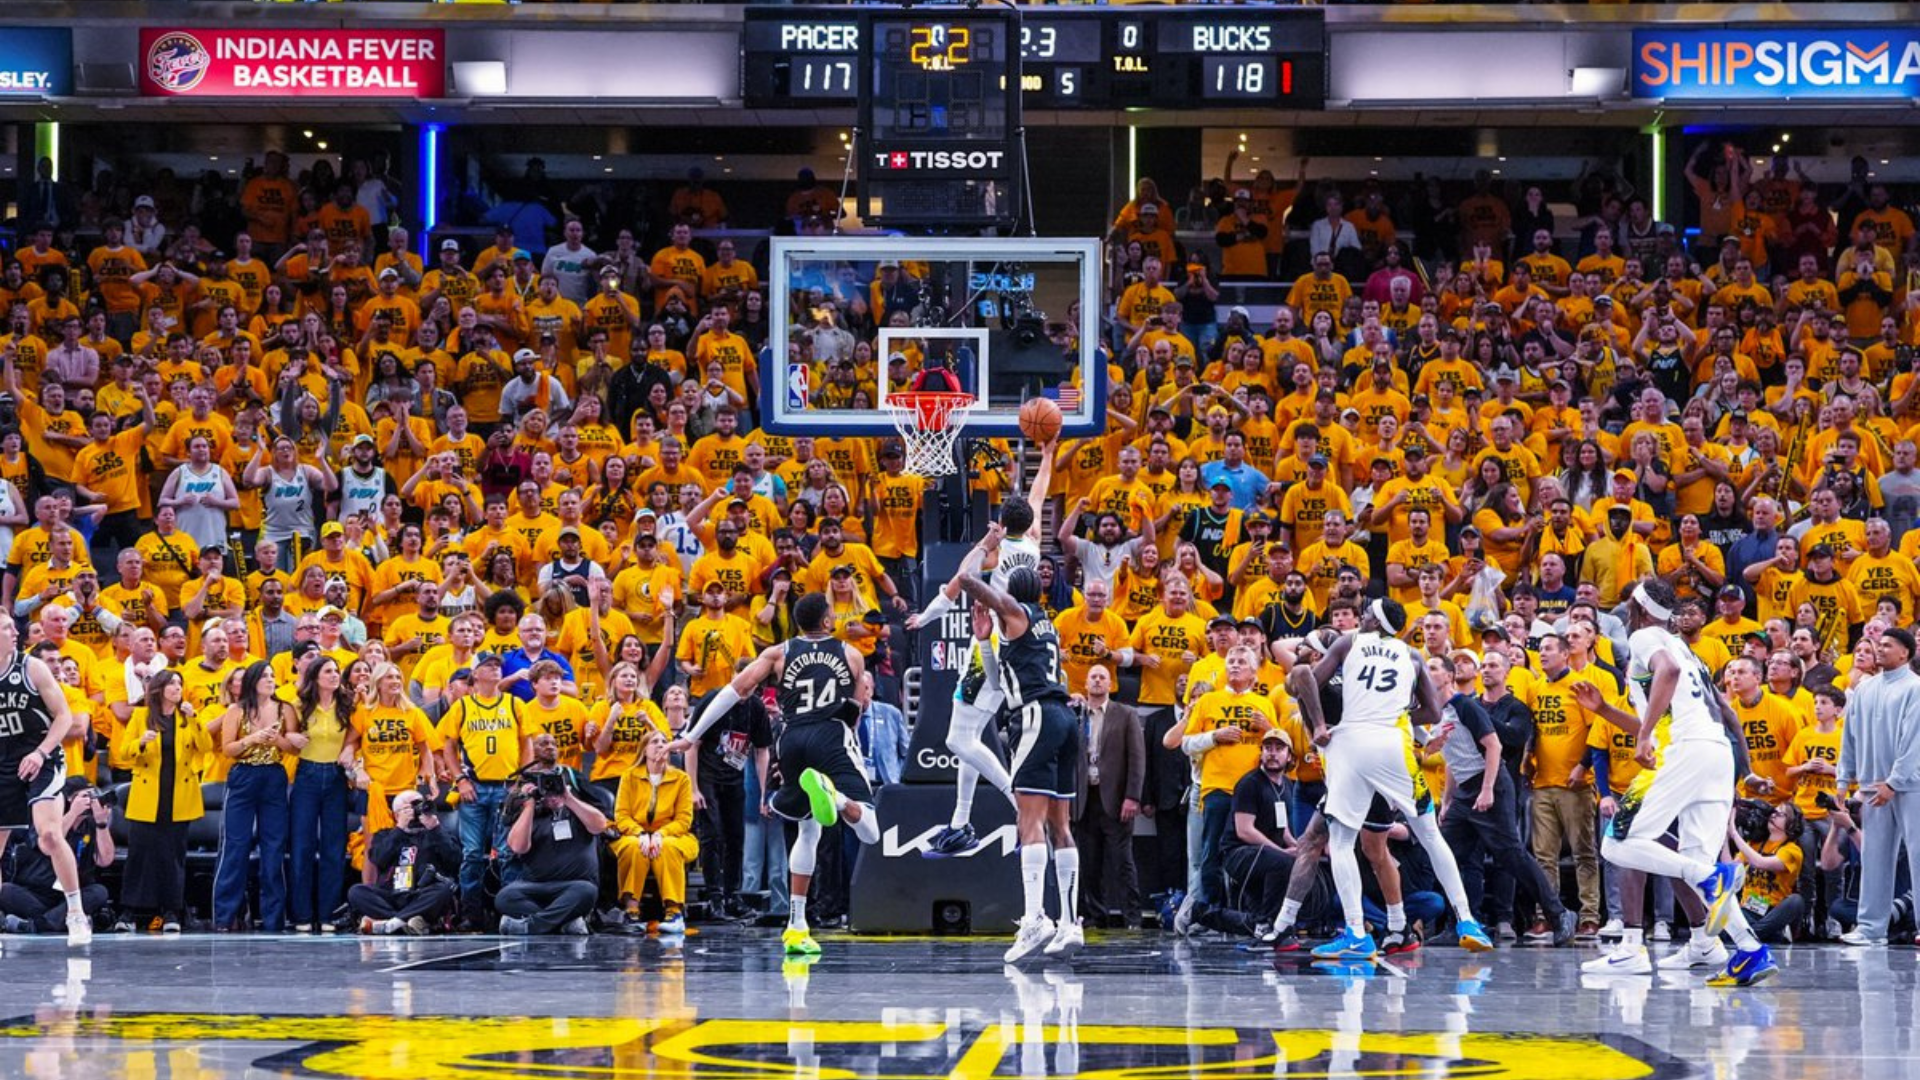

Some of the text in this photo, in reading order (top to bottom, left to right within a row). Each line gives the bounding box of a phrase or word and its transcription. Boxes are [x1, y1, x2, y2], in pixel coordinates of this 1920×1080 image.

[782, 25, 859, 50] PACER
[1123, 25, 1137, 48] 0
[1192, 26, 1271, 51] BUCKS
[216, 38, 435, 60] INDIANA FEVER
[1114, 57, 1148, 71] T.O.L.
[234, 65, 418, 87] BASKETBALL
[803, 63, 851, 90] 117
[1216, 63, 1264, 92] 118
[910, 151, 1004, 168] TISSOT
[1312, 283, 1334, 293] YES
[1309, 292, 1338, 302] CERS
[1386, 317, 1408, 326] YES
[715, 347, 738, 356] YES
[1438, 371, 1460, 380] YES
[1370, 405, 1394, 415] YES
[190, 429, 213, 438] YES
[764, 437, 788, 446] YES
[1250, 437, 1271, 446] YES
[715, 449, 740, 460] YES
[826, 450, 850, 460] YES
[886, 486, 909, 497] YES
[1113, 490, 1129, 500] YE
[297, 500, 304, 512] 2
[883, 497, 913, 508] CERS
[1302, 499, 1326, 509] YES
[518, 528, 544, 537] YES
[1202, 528, 1224, 540] IND
[1820, 532, 1846, 542] YES
[35, 541, 51, 551] YE
[676, 527, 704, 555] 13
[398, 571, 425, 581] YES
[716, 570, 743, 580] YES
[1246, 565, 1270, 575] CER
[1866, 567, 1893, 578] YES
[1861, 577, 1898, 589] CERS
[1810, 595, 1836, 606] YES
[941, 611, 970, 638] THE
[1158, 625, 1185, 636] YES
[490, 644, 517, 654] YES
[1361, 646, 1399, 662] SIAKAM
[1046, 644, 1059, 682] 3
[783, 651, 851, 690] ANTETOKOUNMPO
[1357, 665, 1398, 692] 43
[796, 678, 836, 714] 34
[1537, 696, 1561, 707] YES
[1221, 706, 1254, 718] YES
[0, 711, 24, 736] 20
[374, 719, 405, 730] YES
[541, 718, 573, 732] YES
[616, 716, 645, 728] YES
[554, 731, 579, 746] ERS
[1612, 734, 1637, 748] CE
[1747, 734, 1776, 749] ERS
[486, 736, 496, 755] 0
[917, 748, 959, 768] Goo
[1804, 746, 1836, 761] YES
